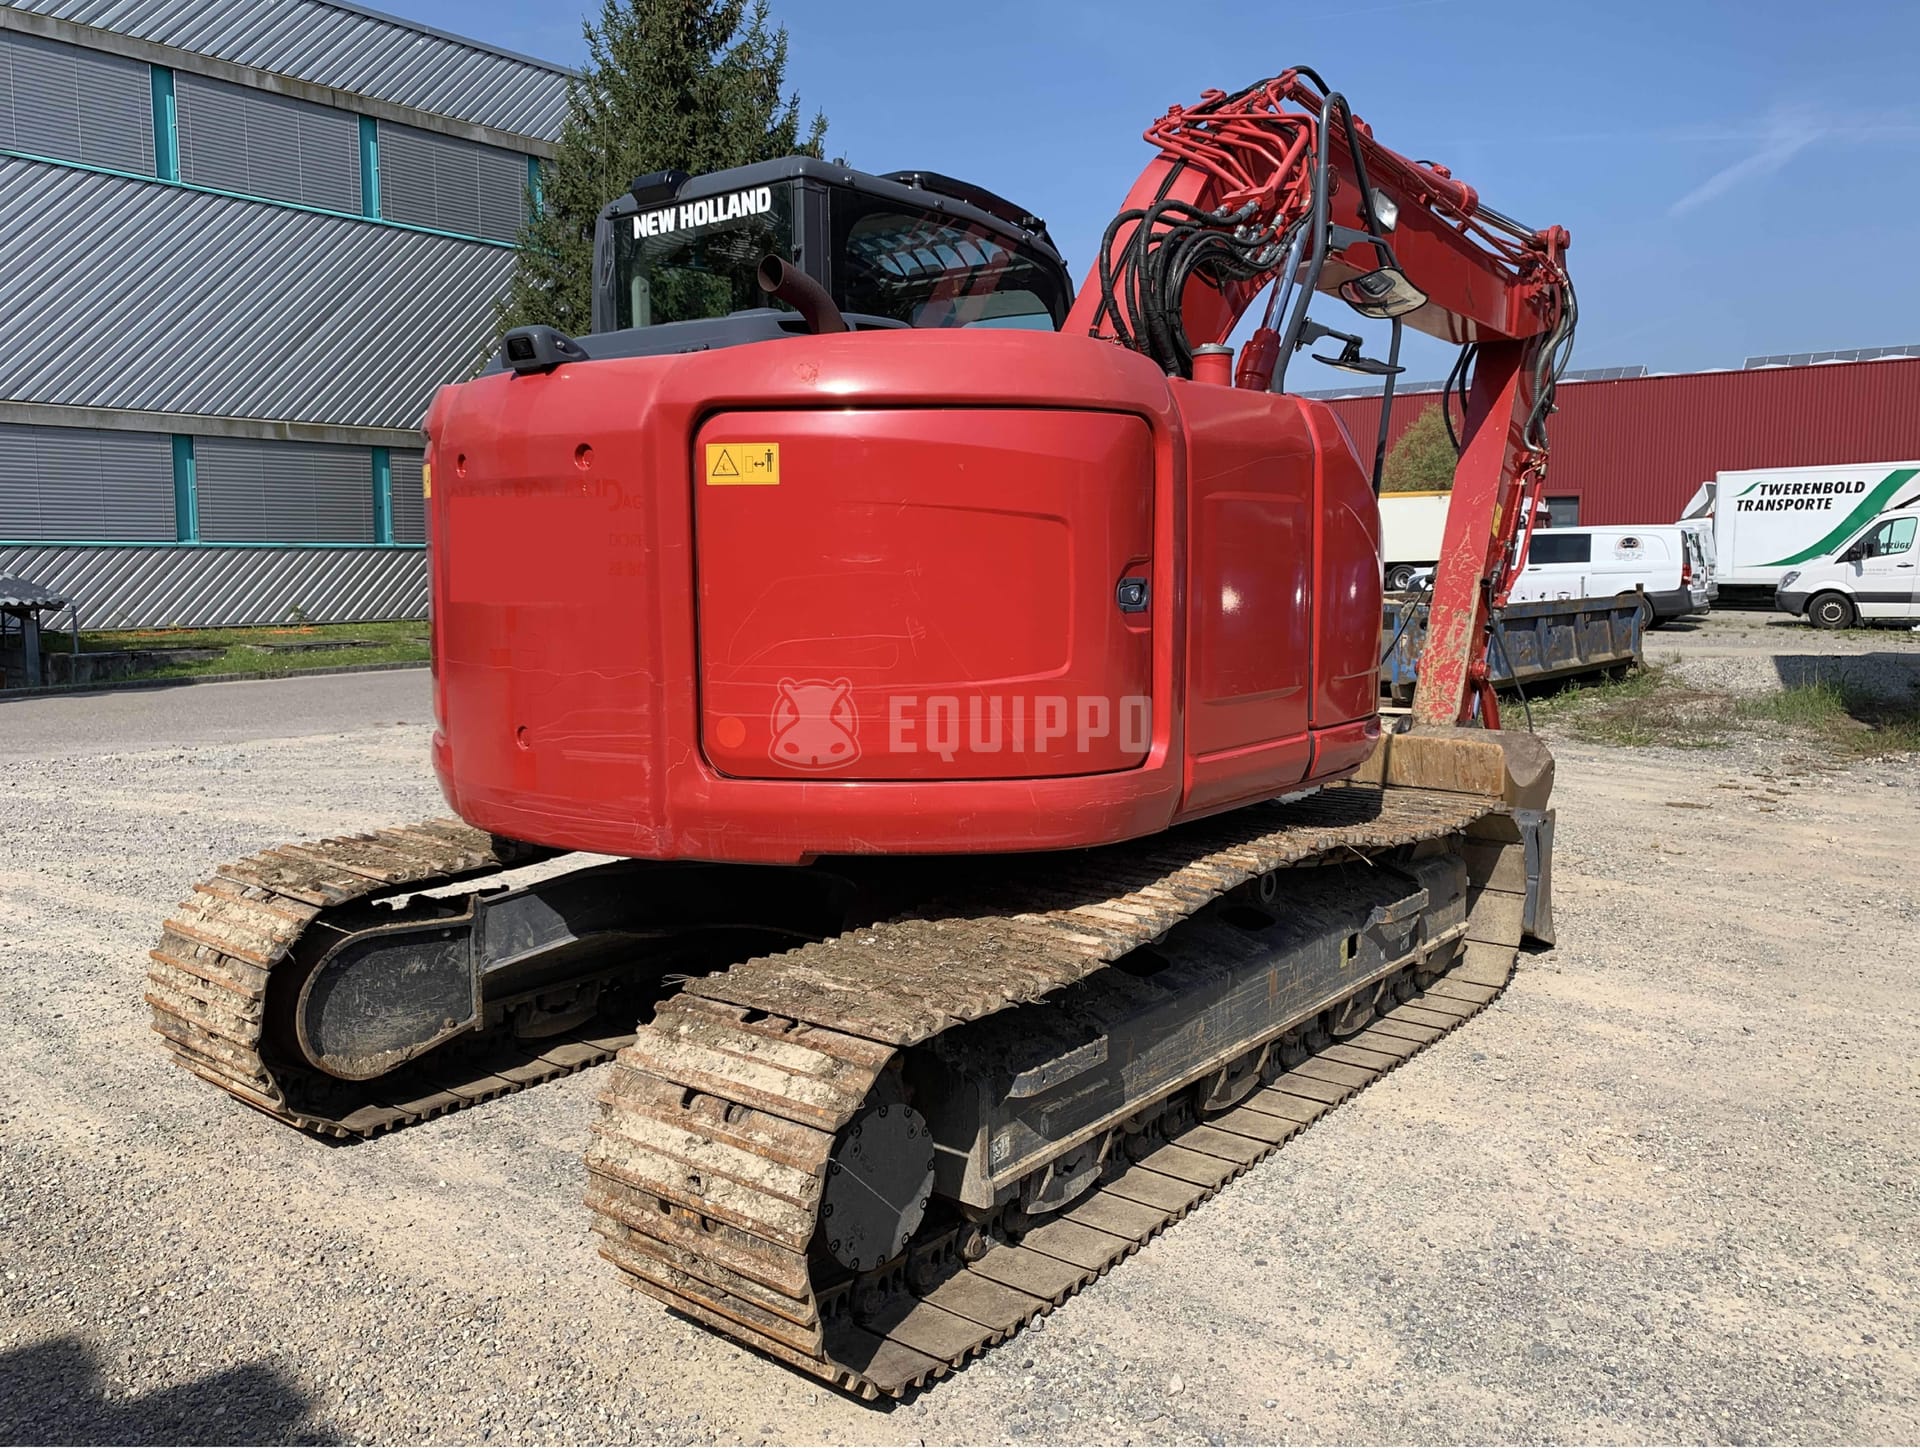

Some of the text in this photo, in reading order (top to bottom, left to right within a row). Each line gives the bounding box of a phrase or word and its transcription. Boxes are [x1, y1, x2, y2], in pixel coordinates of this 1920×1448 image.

[633, 186, 772, 240] NEW HOLLAND
[1760, 481, 1866, 496] TWERENBOLD
[1736, 497, 1833, 512] TRANSPORTE
